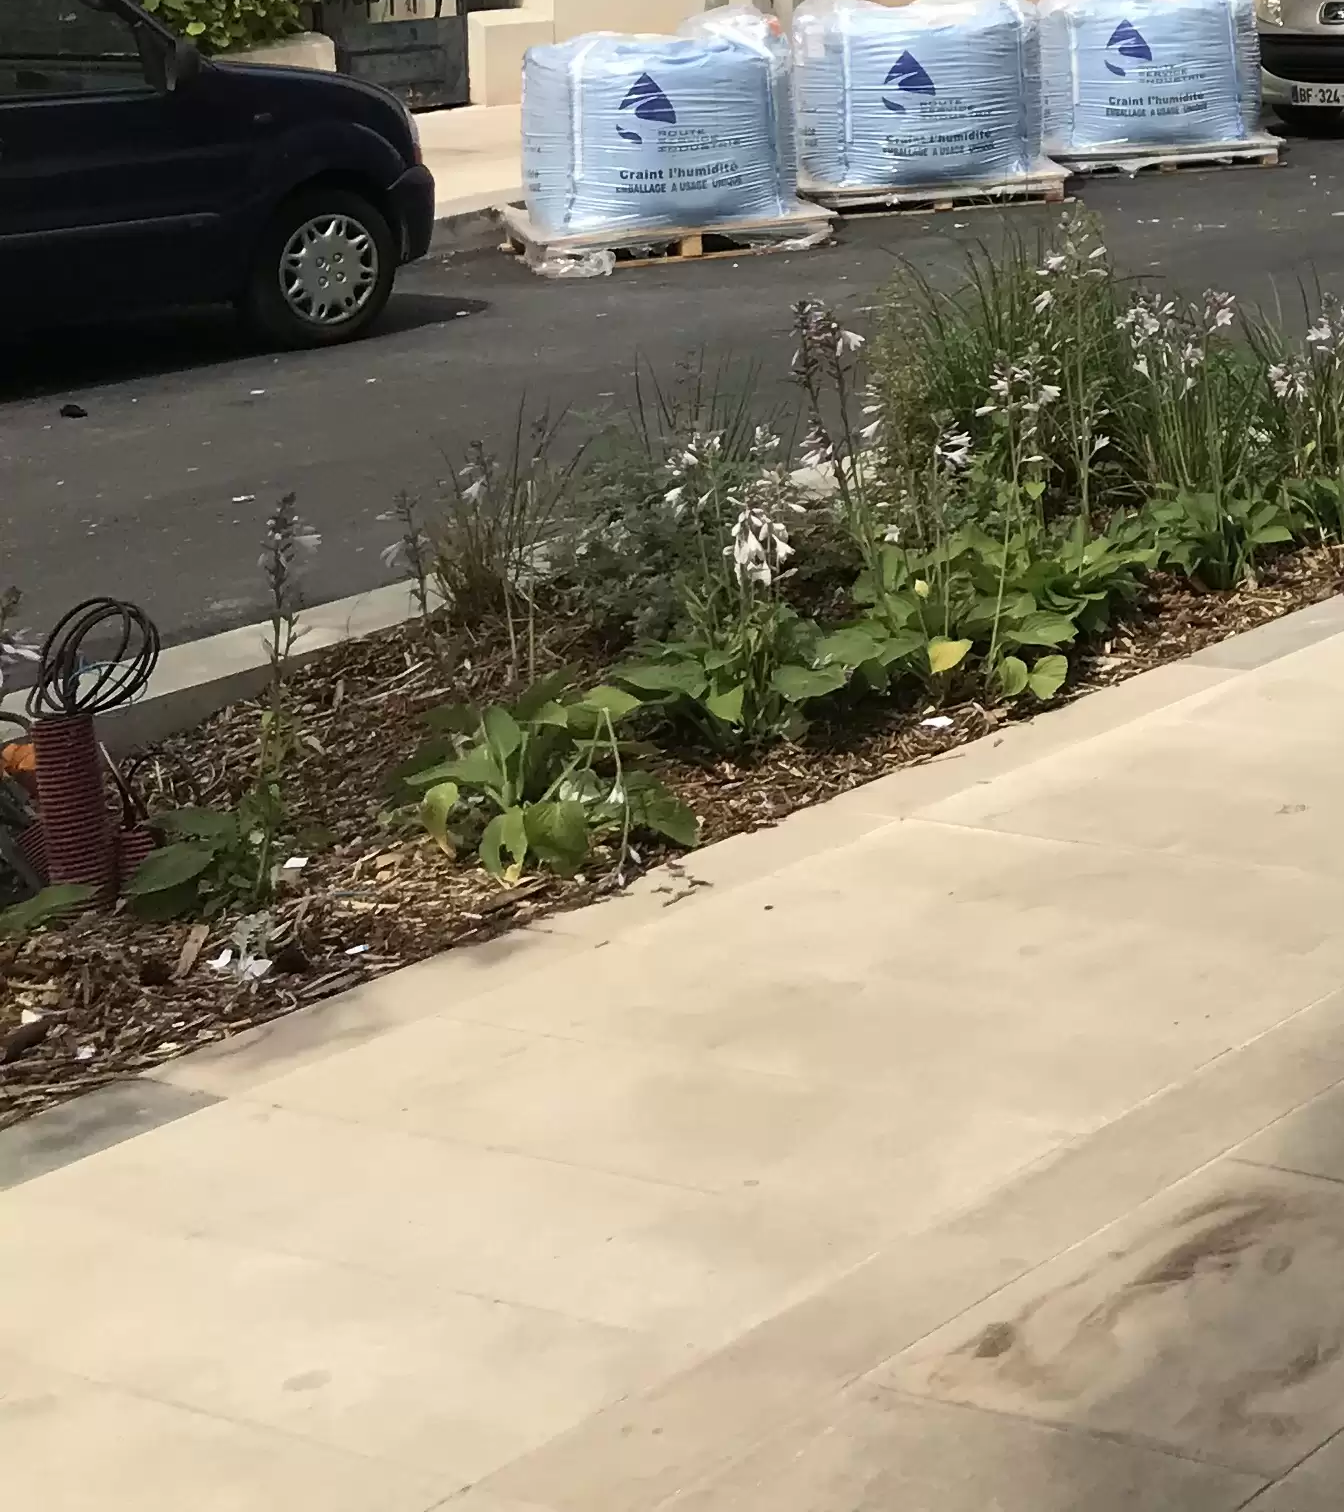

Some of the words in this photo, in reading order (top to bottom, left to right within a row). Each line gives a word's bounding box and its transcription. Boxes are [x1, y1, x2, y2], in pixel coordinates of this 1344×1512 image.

[1108, 96, 1144, 106] Craint
[619, 169, 664, 180] Craint
[615, 183, 667, 194] EMBALLAGE
[679, 179, 708, 191] USAGE
